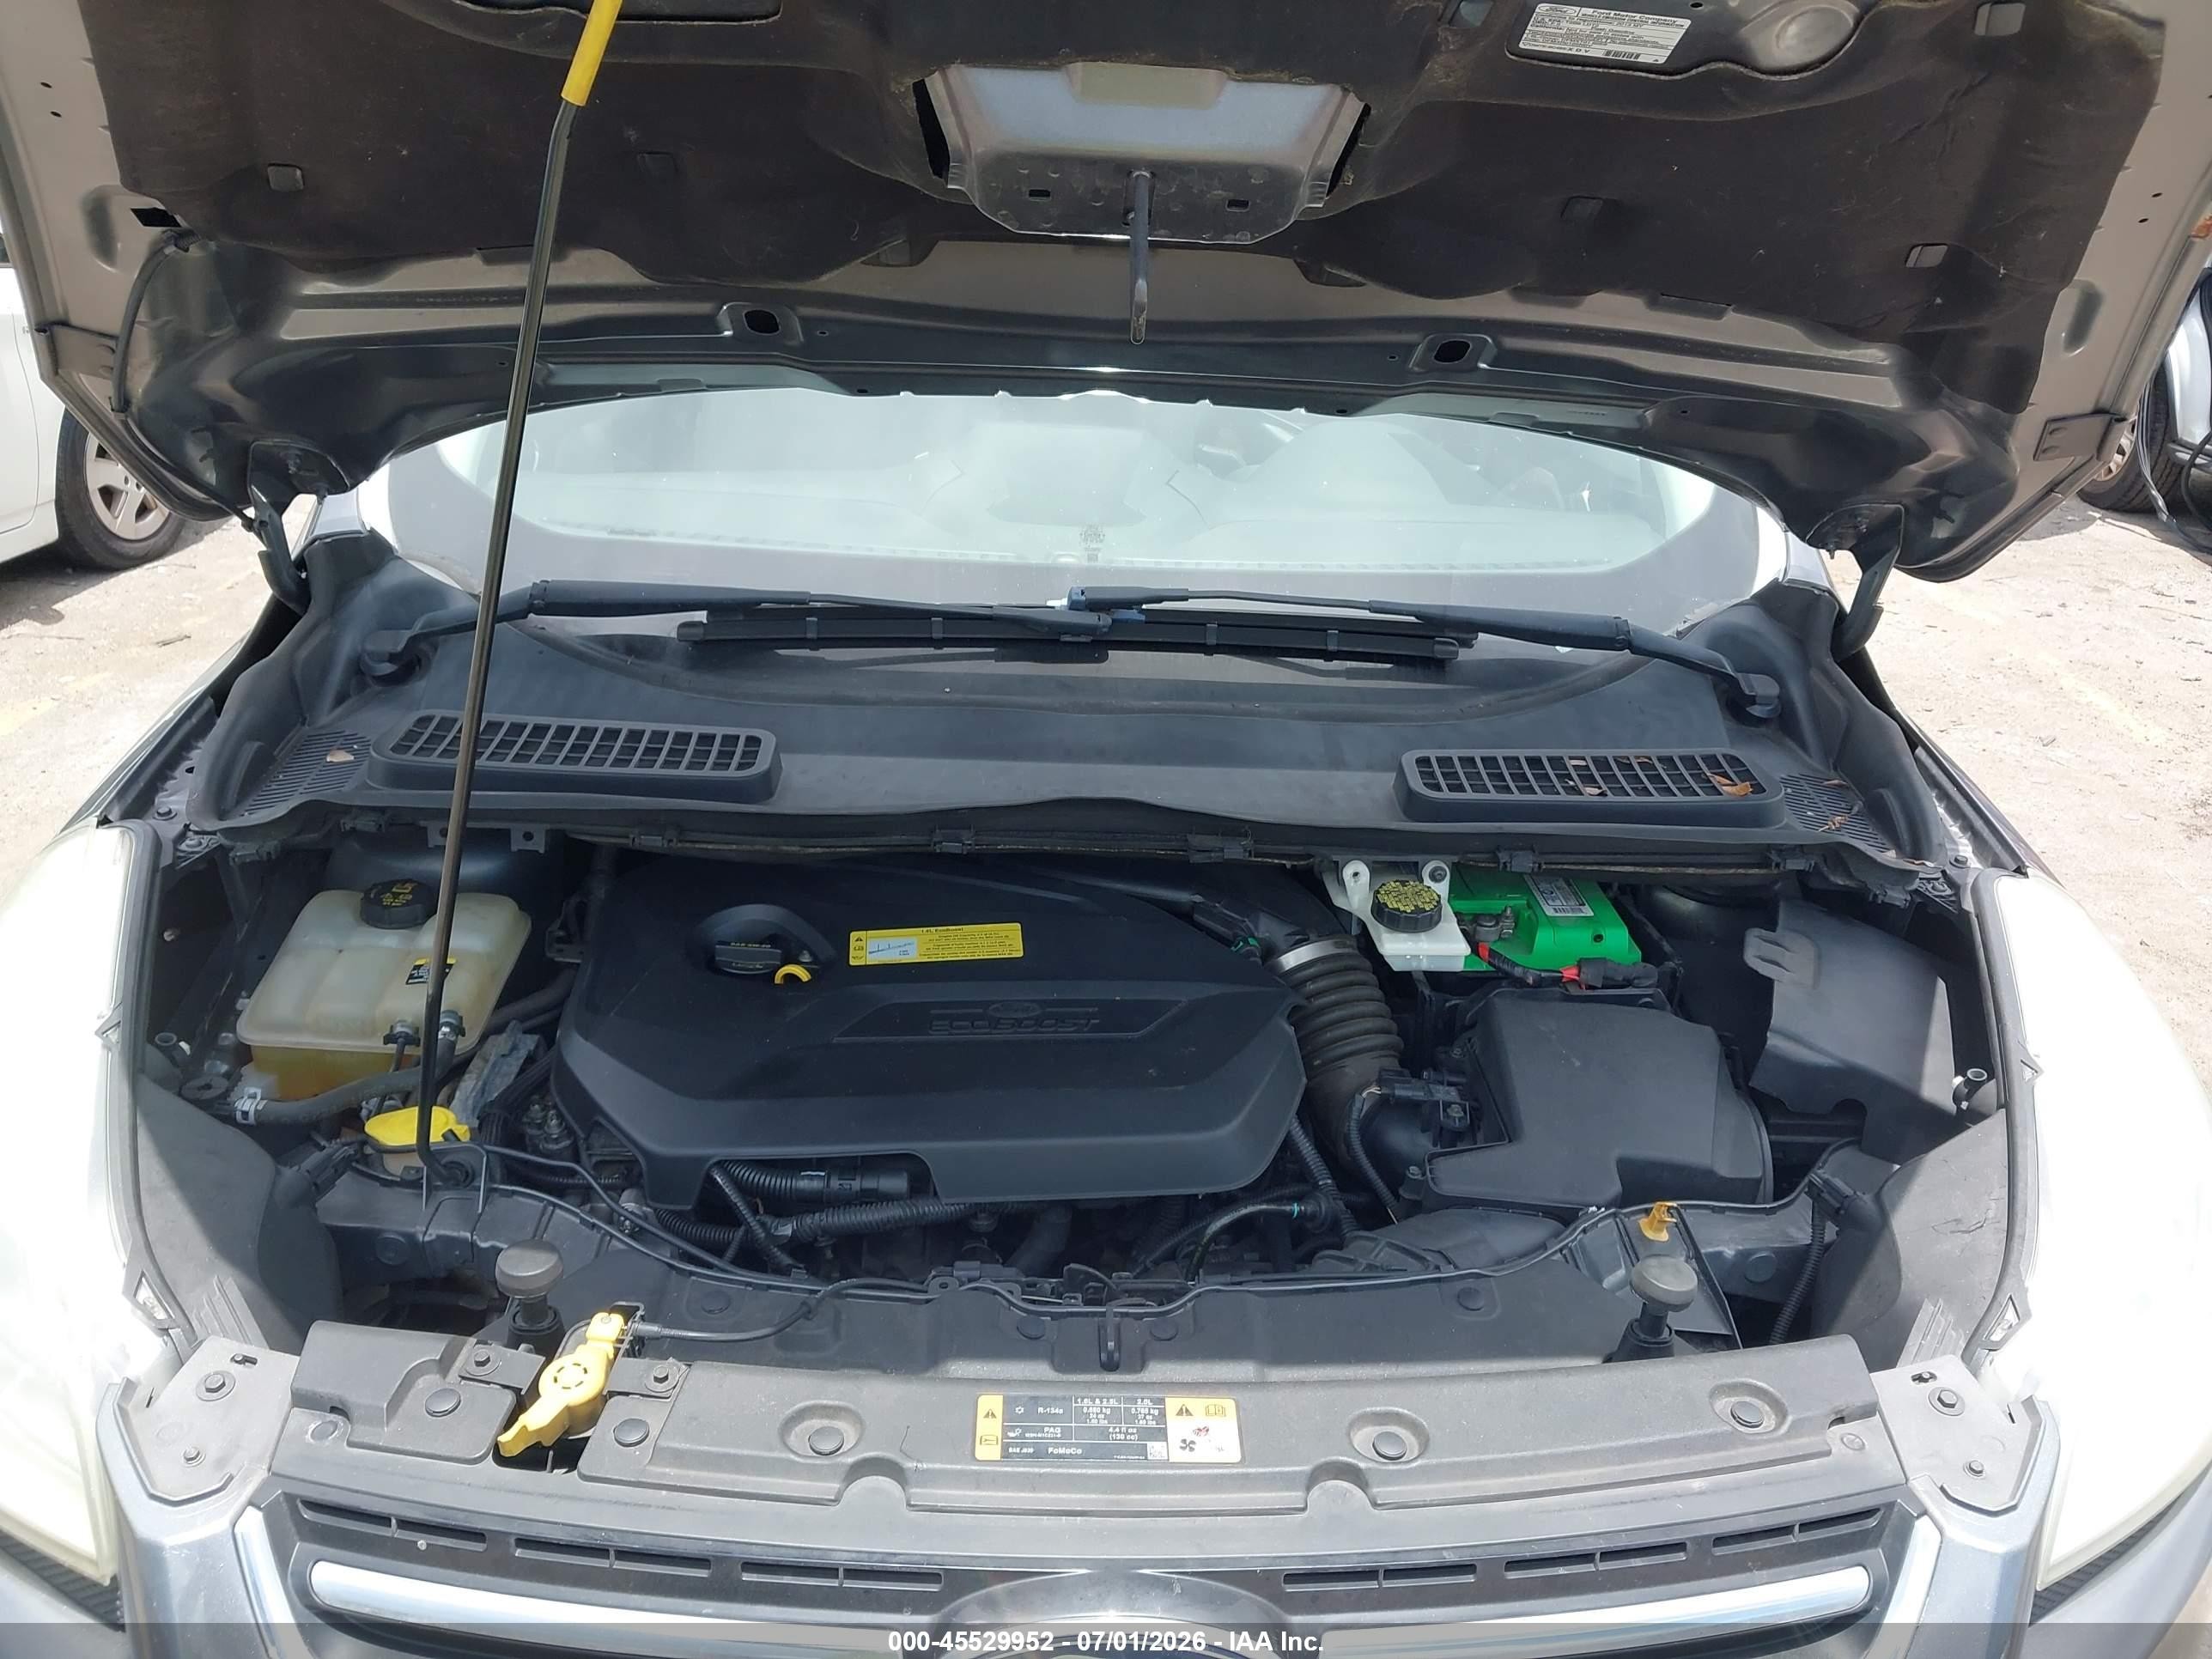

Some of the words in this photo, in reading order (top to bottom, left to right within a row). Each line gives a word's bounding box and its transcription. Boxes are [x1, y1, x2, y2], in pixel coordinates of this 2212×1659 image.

[1638, 15, 1678, 24] Company
[928, 1019, 1100, 1035] ECOBOOST
[1102, 1407, 1111, 1415] kg
[1150, 1407, 1159, 1416] kg
